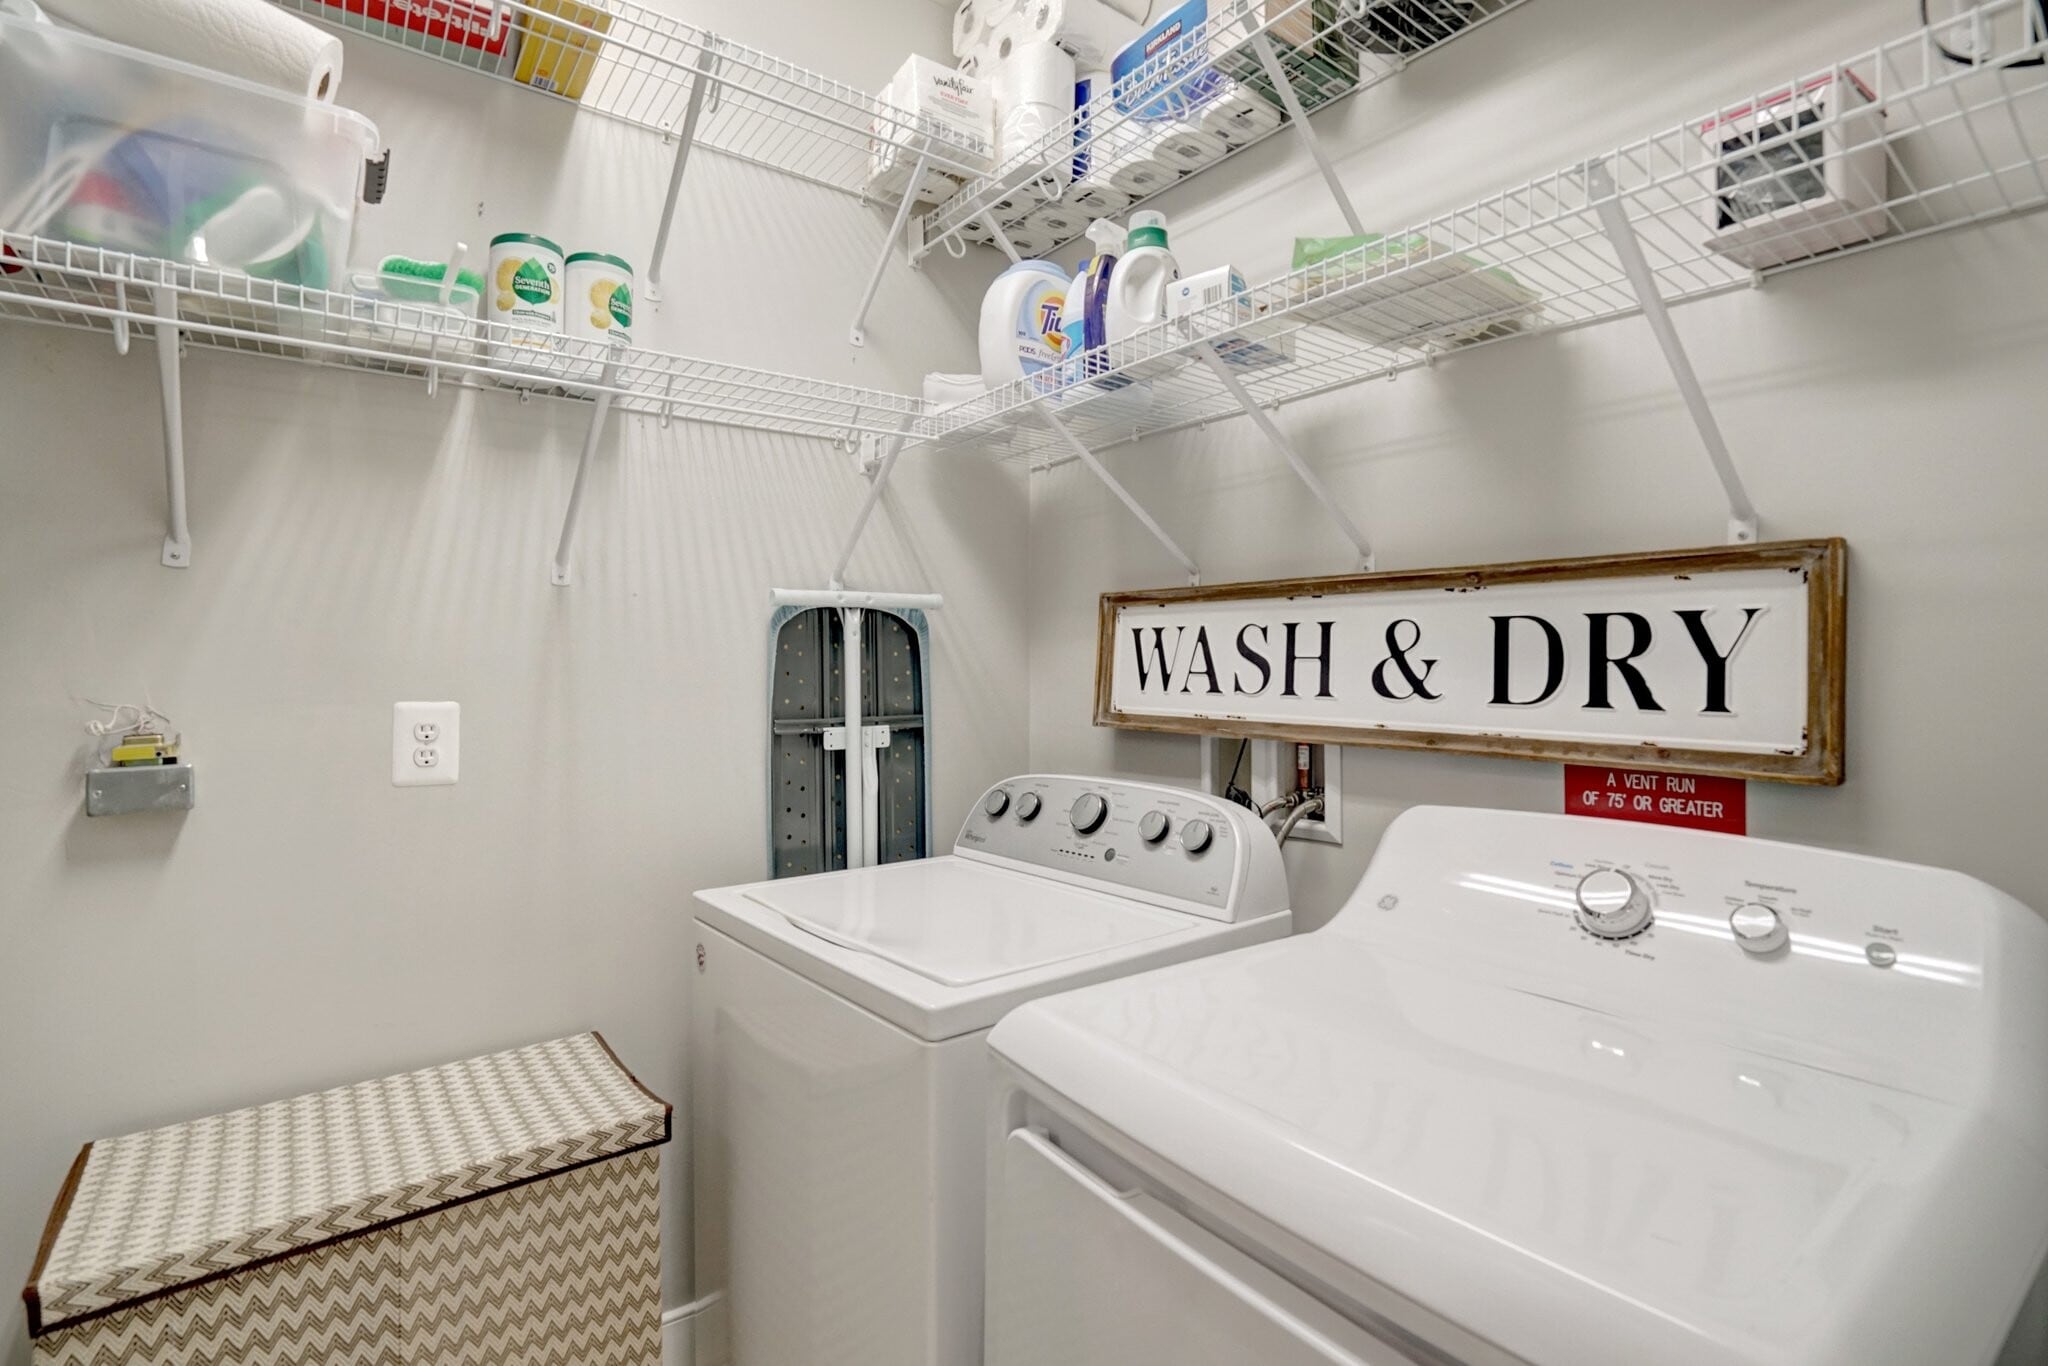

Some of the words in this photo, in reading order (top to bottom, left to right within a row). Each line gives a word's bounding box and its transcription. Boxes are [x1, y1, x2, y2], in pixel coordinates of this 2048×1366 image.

[1146, 21, 1181, 53] KIRKLAND
[514, 275, 550, 291] Seventh
[1131, 620, 1336, 698] WASH
[1371, 618, 1443, 700] &
[1487, 607, 1764, 713] DRY
[1606, 772, 1616, 787] A
[1623, 774, 1660, 791] VENT
[1666, 776, 1696, 794] RUN
[1582, 790, 1600, 806] OF
[1633, 796, 1653, 812] OR
[1659, 797, 1724, 818] GREATER
